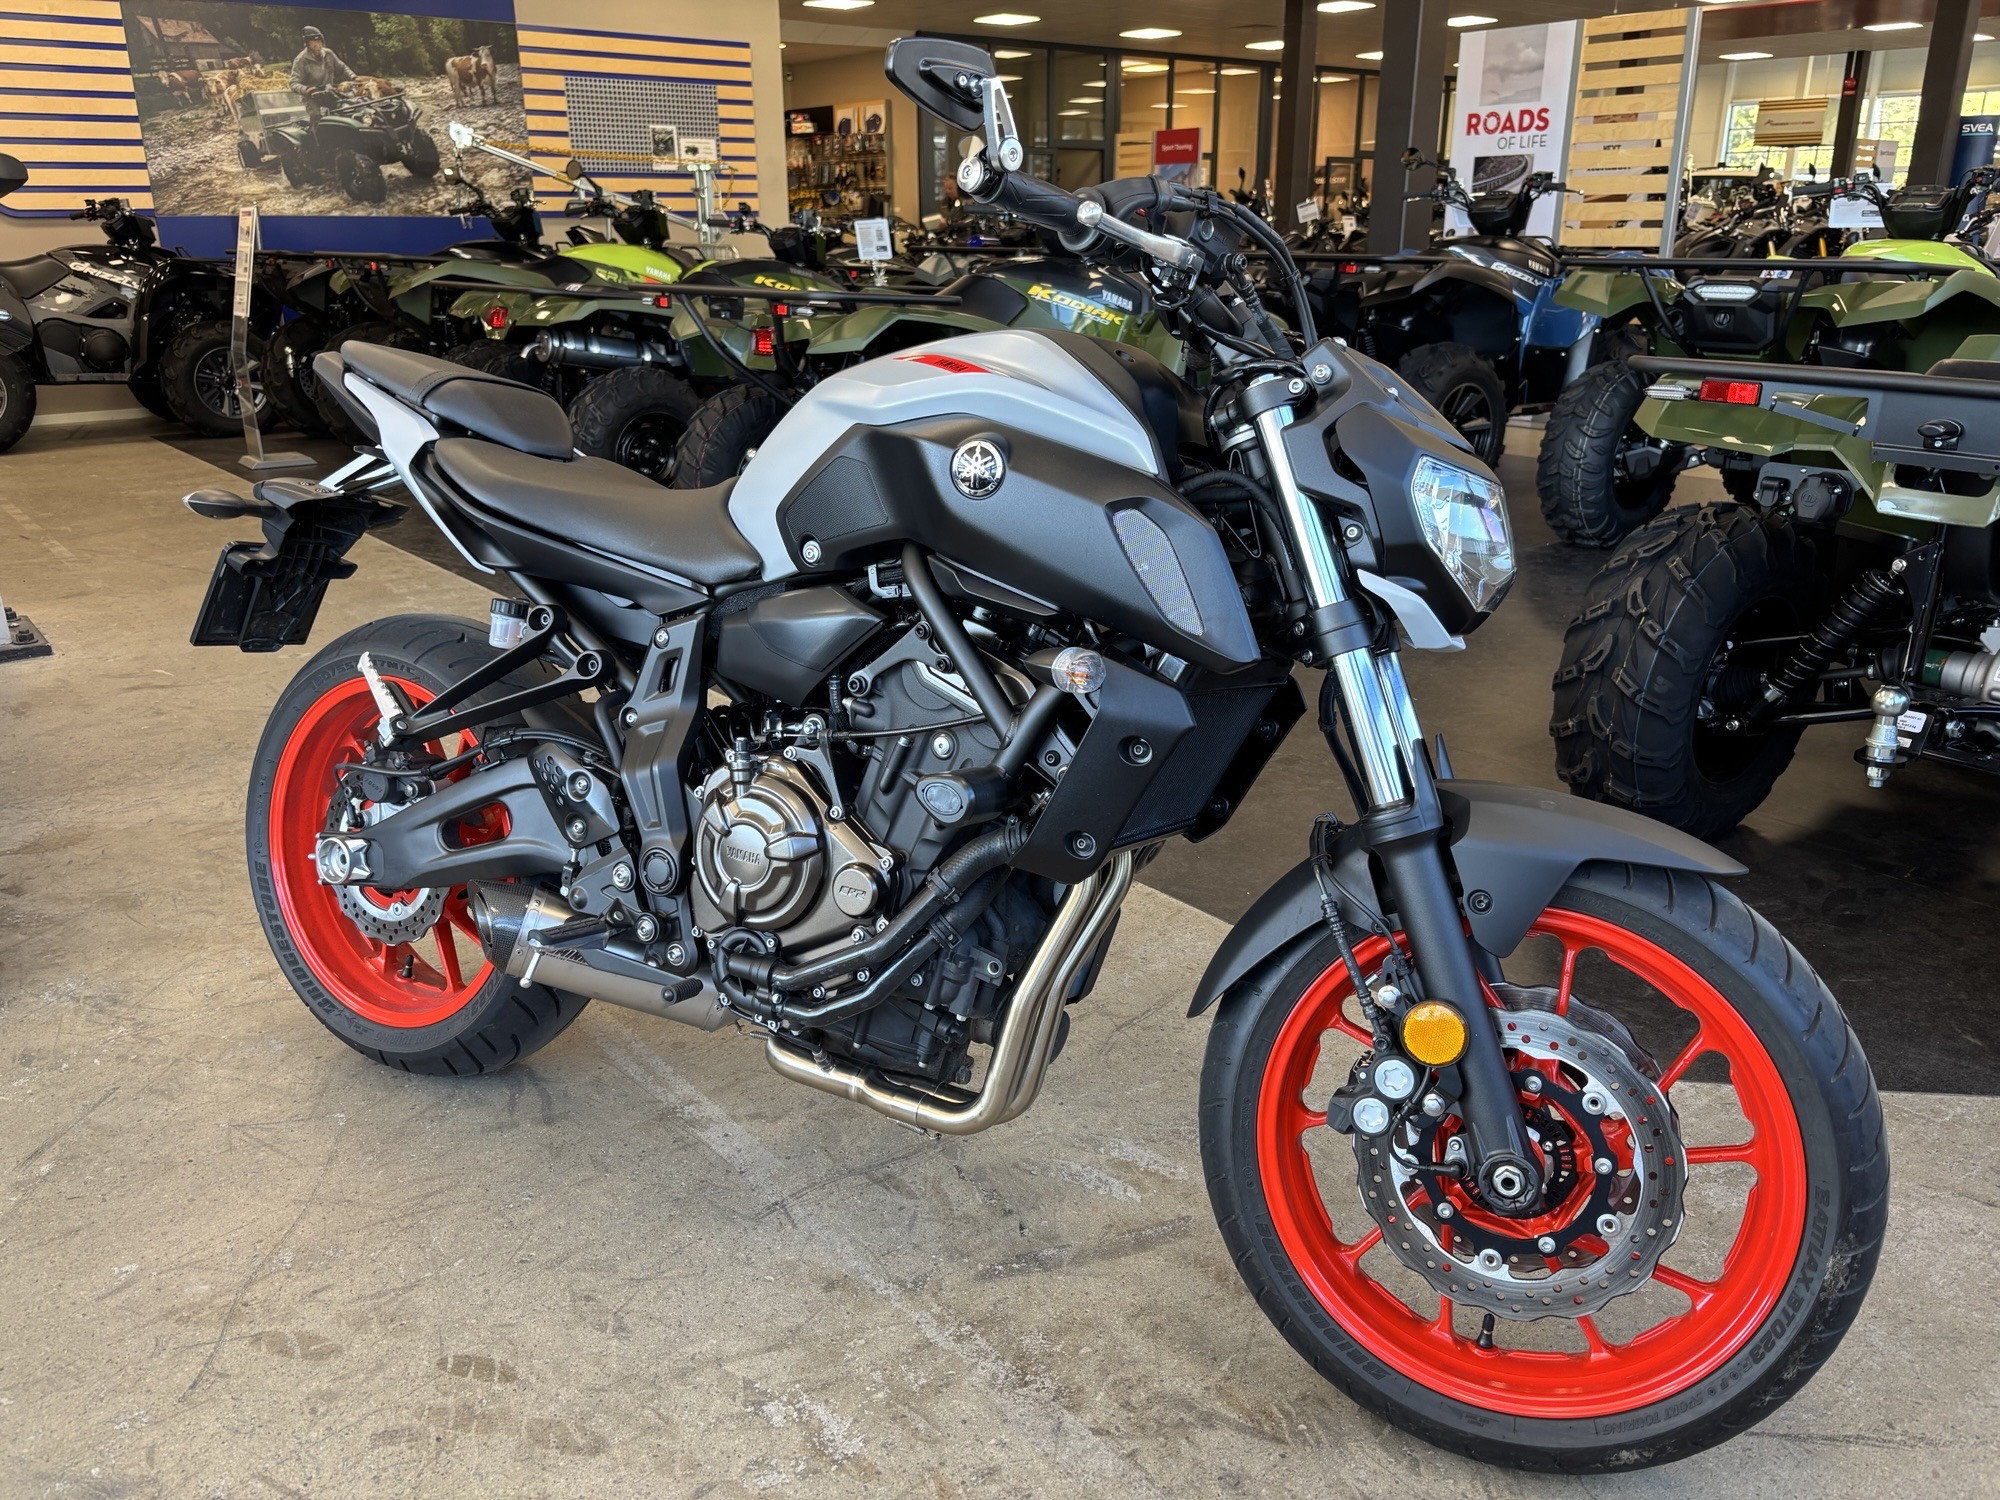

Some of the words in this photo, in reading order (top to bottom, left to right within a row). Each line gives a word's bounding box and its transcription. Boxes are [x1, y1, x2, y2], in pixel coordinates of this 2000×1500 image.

[1466, 107, 1550, 136] ROADS
[1961, 123, 1994, 133] SVEA
[1497, 136, 1516, 150] OF
[1519, 134, 1548, 149] LIFE
[645, 265, 672, 281] YAMAHA
[1490, 261, 1543, 287] GRIZZLY
[1027, 285, 1124, 325] KODIAK
[1102, 289, 1133, 312] YAMAHA
[727, 845, 761, 865] YAMAHA
[254, 860, 340, 1015] BRIDGESTONE
[1254, 1221, 1392, 1381] BRIDGESTONE
[1663, 1392, 1704, 1421] SPORT
[1602, 1412, 1661, 1436] TOURING
